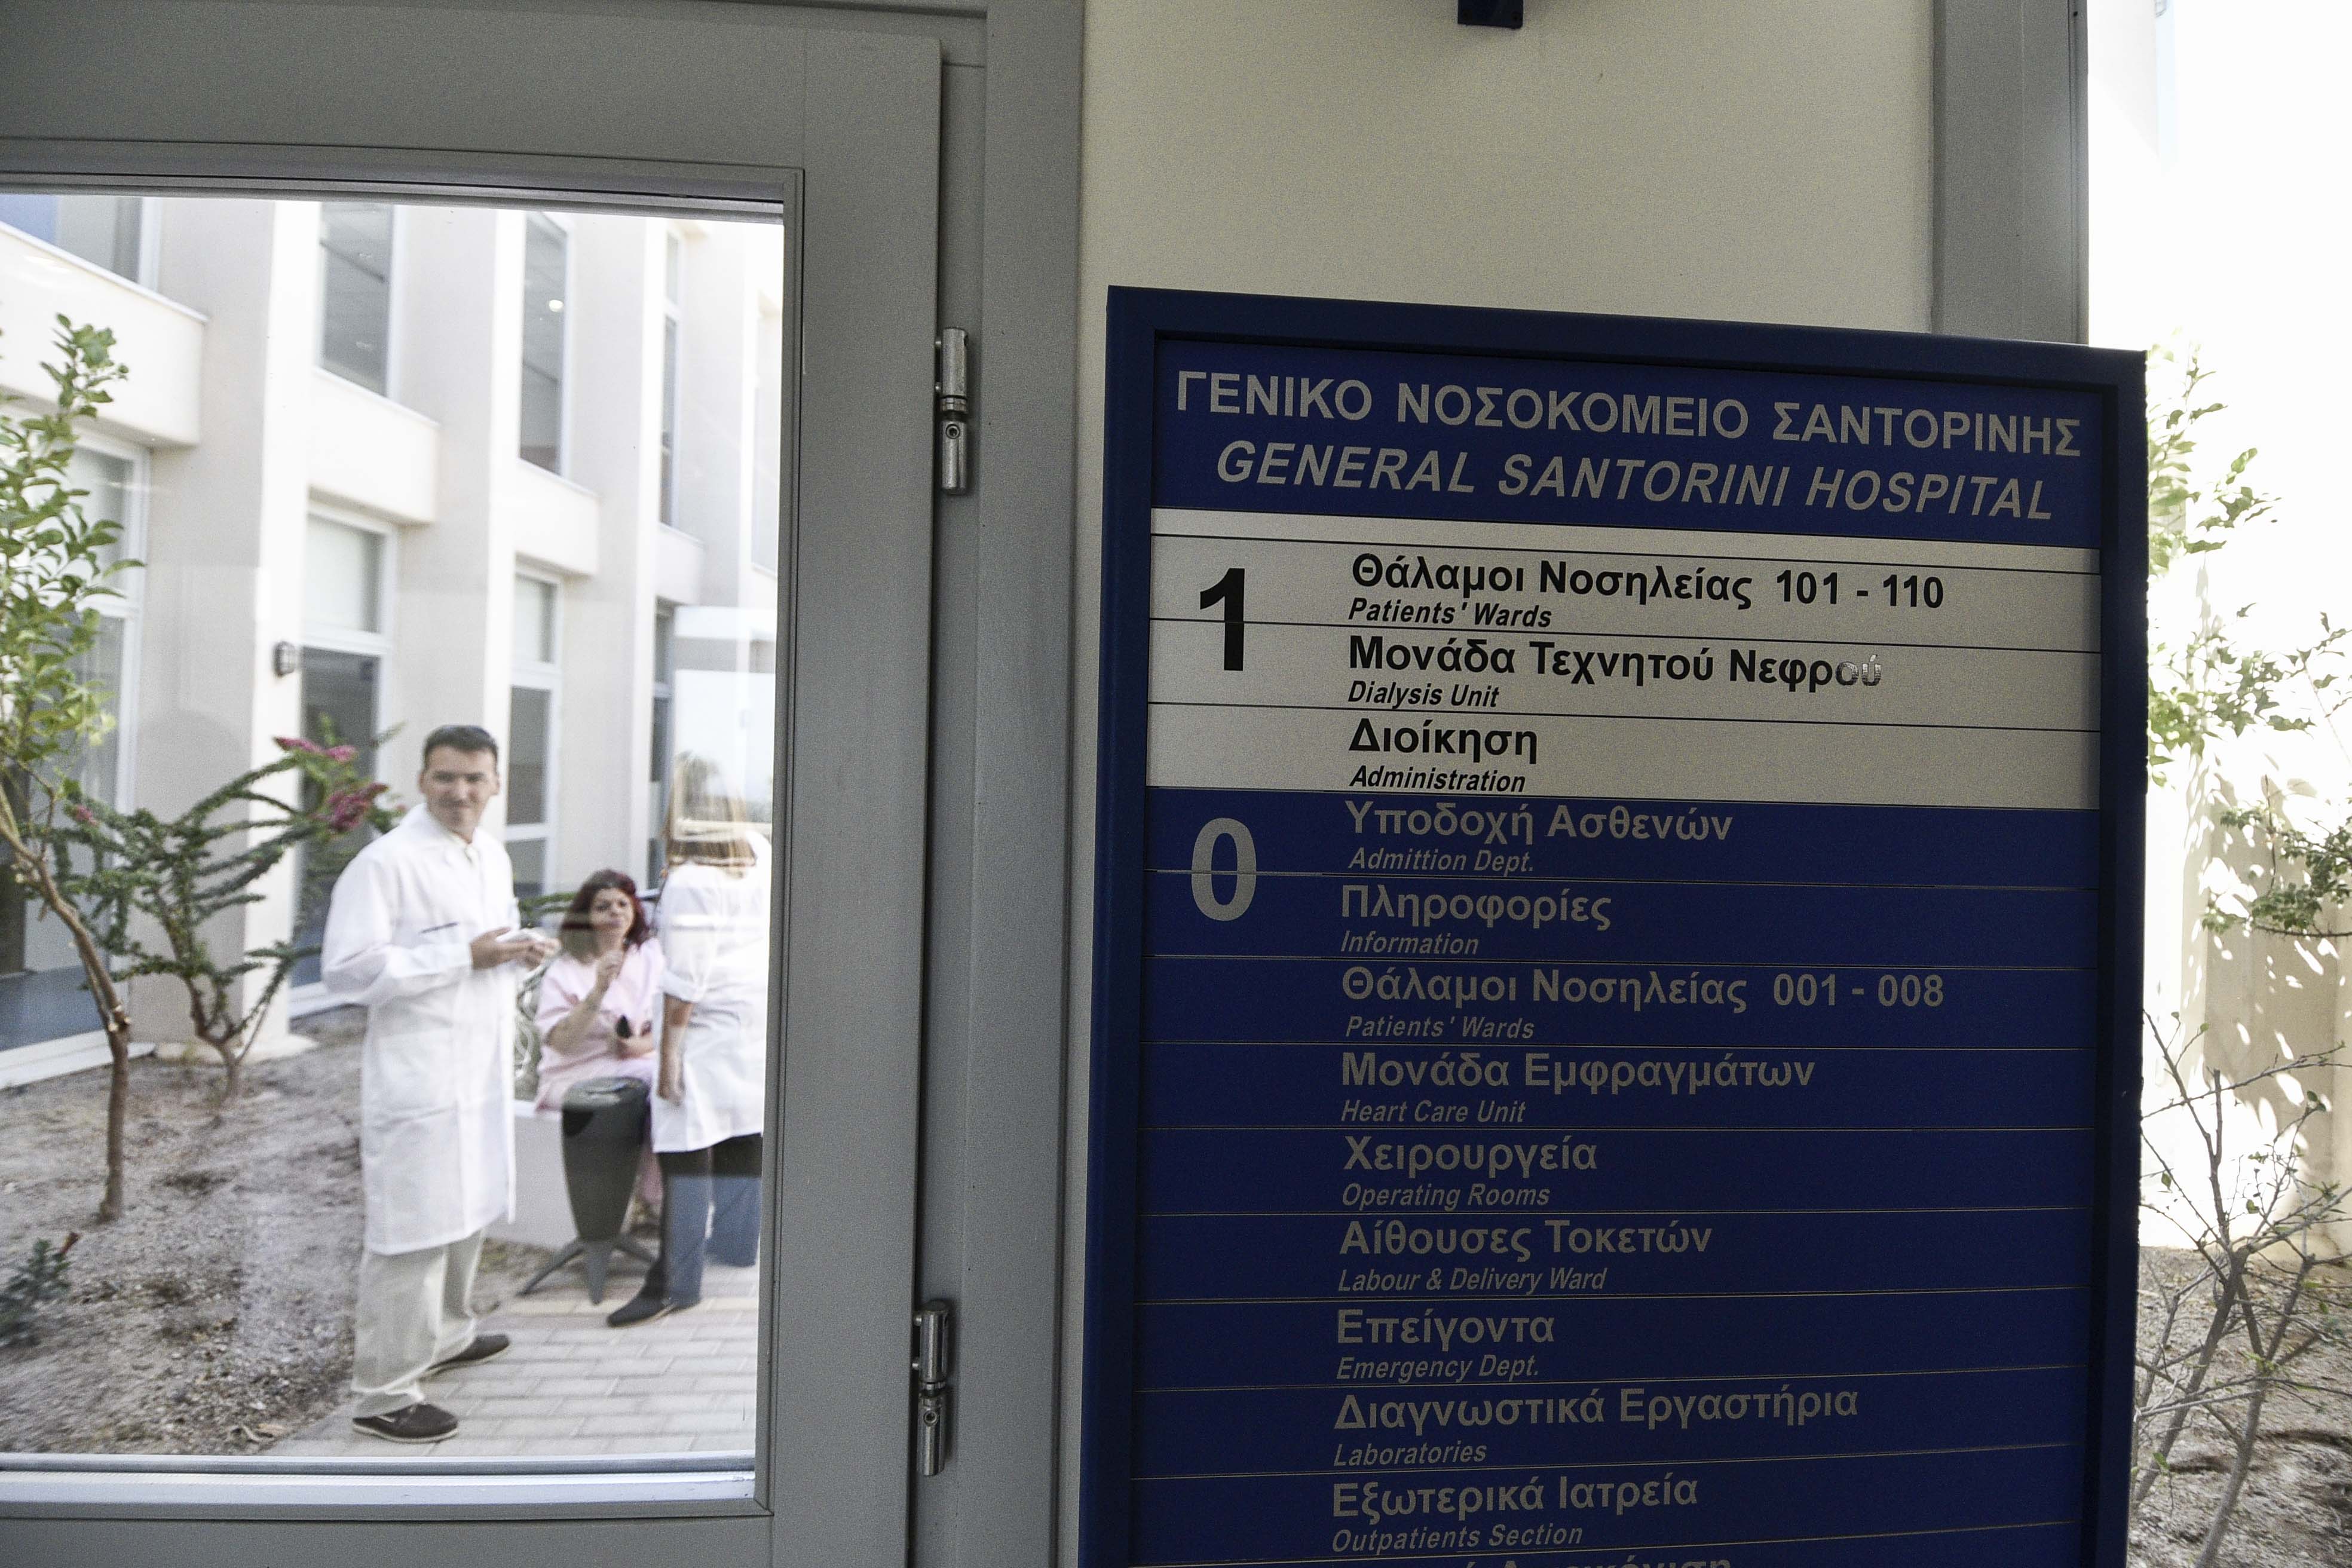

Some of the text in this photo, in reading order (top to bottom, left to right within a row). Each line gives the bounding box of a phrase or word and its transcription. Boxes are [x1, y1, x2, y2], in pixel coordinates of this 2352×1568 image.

[1178, 371, 2080, 456] ΓΕΝΙΚΟ ΝΟΣΟΚΟΜΕΙΟ ΣΑΝΤΟΡΙΝΗΣ
[1218, 440, 2050, 519] GENERAL SANTORINI HOSPITAL
[1353, 553, 1523, 604] Θάλαμοι
[1541, 561, 1751, 610] Νοσηλείας
[1777, 570, 1837, 604] 101
[1884, 575, 1943, 608] 110
[1199, 568, 1245, 670] 1
[1475, 603, 1551, 627] Wards
[1350, 636, 1879, 693] Μονάδα Τεχνητού Νεφρού
[1348, 681, 1499, 710] Dialysis Unit
[1349, 718, 1536, 764] Διοίκηση
[1350, 764, 1526, 792] Administration
[1346, 801, 1732, 844] Υποδοχή Ασθενών
[1190, 817, 1256, 921] 0
[1349, 847, 1534, 875] Admittion Dept.
[1342, 885, 1611, 930] Πληροφορίες
[1342, 931, 1478, 954] Information
[1343, 966, 1515, 1008] Θάλαμοι
[1533, 969, 1746, 1013] Νοσηλείας
[1774, 974, 1835, 1005] 001
[1879, 975, 1943, 1006] 008
[1463, 1016, 1534, 1039] Wards
[1343, 1052, 1814, 1094] Μονάδα Εμφραγμάτων
[1342, 1100, 1526, 1122] Heart Care Unit
[1345, 1135, 1596, 1178] Χειρουργεία
[1342, 1183, 1549, 1211] Operating Rooms
[1340, 1220, 1711, 1262] Αίθουσες Τοκετών
[1339, 1267, 1607, 1296] Labour & Delivery Ward
[1338, 1309, 1554, 1352] Επείγοντα
[1336, 1354, 1539, 1383] Emergency Dept.
[1335, 1385, 1857, 1435] Διαγνωστικά Εργαστήρια
[1334, 1444, 1486, 1466] Laboratories
[1334, 1472, 1697, 1524] Εξωτερικά Ιατρεία
[1333, 1524, 1582, 1555] Outpatients Section
